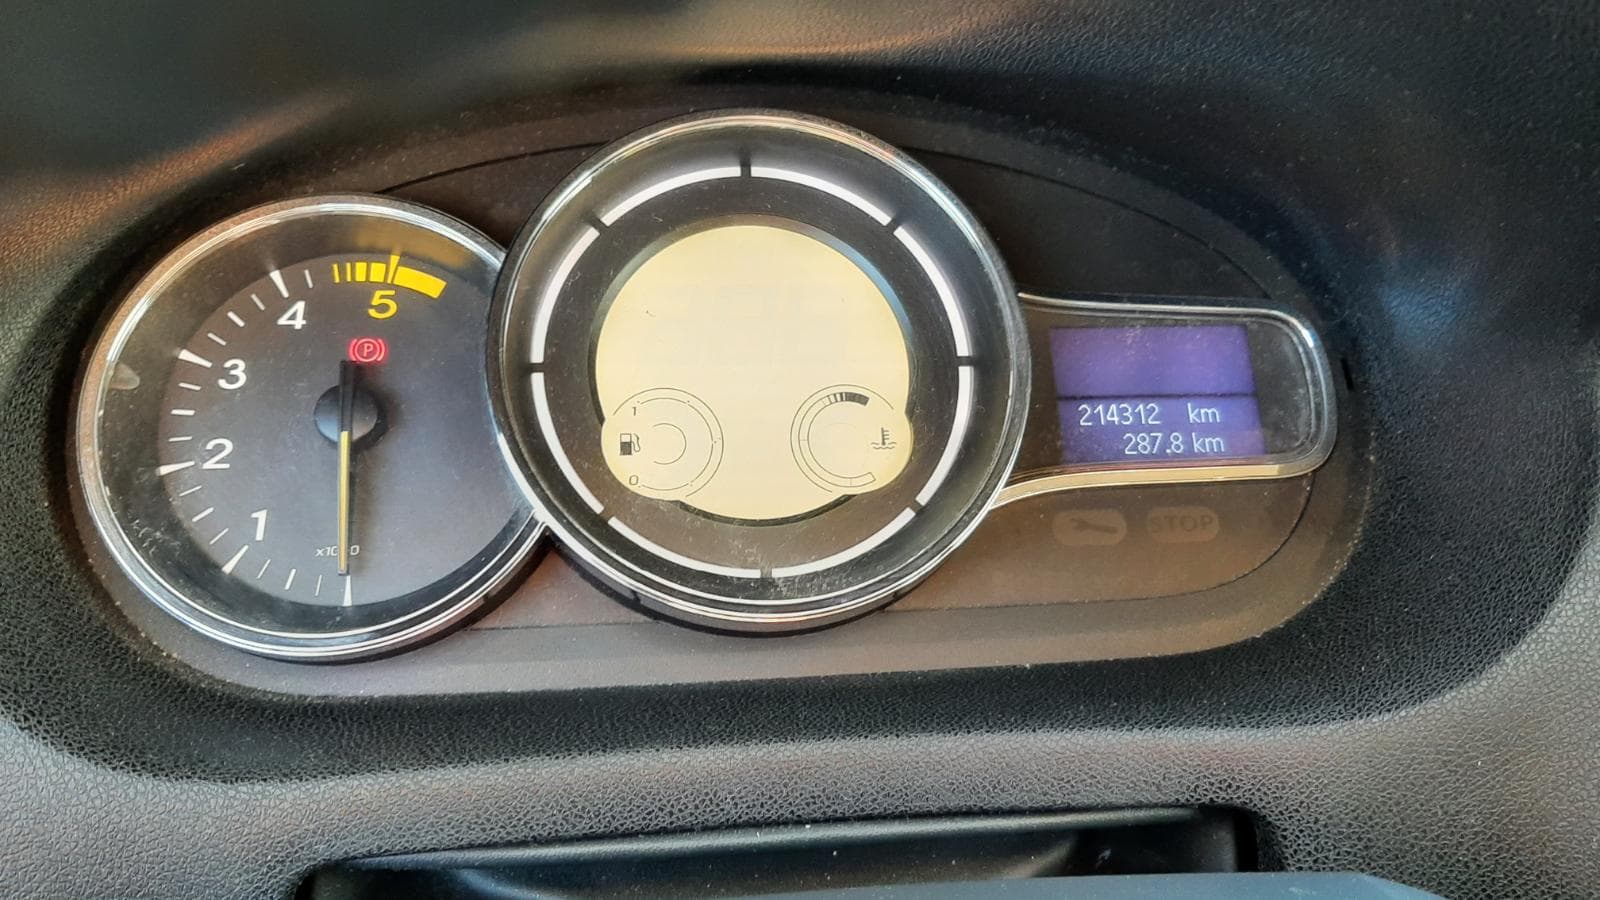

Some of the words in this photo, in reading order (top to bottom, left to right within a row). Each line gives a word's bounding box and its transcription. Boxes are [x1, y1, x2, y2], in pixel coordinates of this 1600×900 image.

[277, 300, 307, 330] 4
[368, 289, 398, 319] 5
[217, 359, 247, 390] 3
[1078, 403, 1162, 426] 214312
[1187, 403, 1221, 424] km
[202, 438, 234, 470] 2
[1122, 432, 1184, 455] 287.8
[1192, 432, 1225, 454] km
[250, 509, 268, 542] 1
[1150, 514, 1214, 533] STOP
[314, 544, 360, 557] x100
